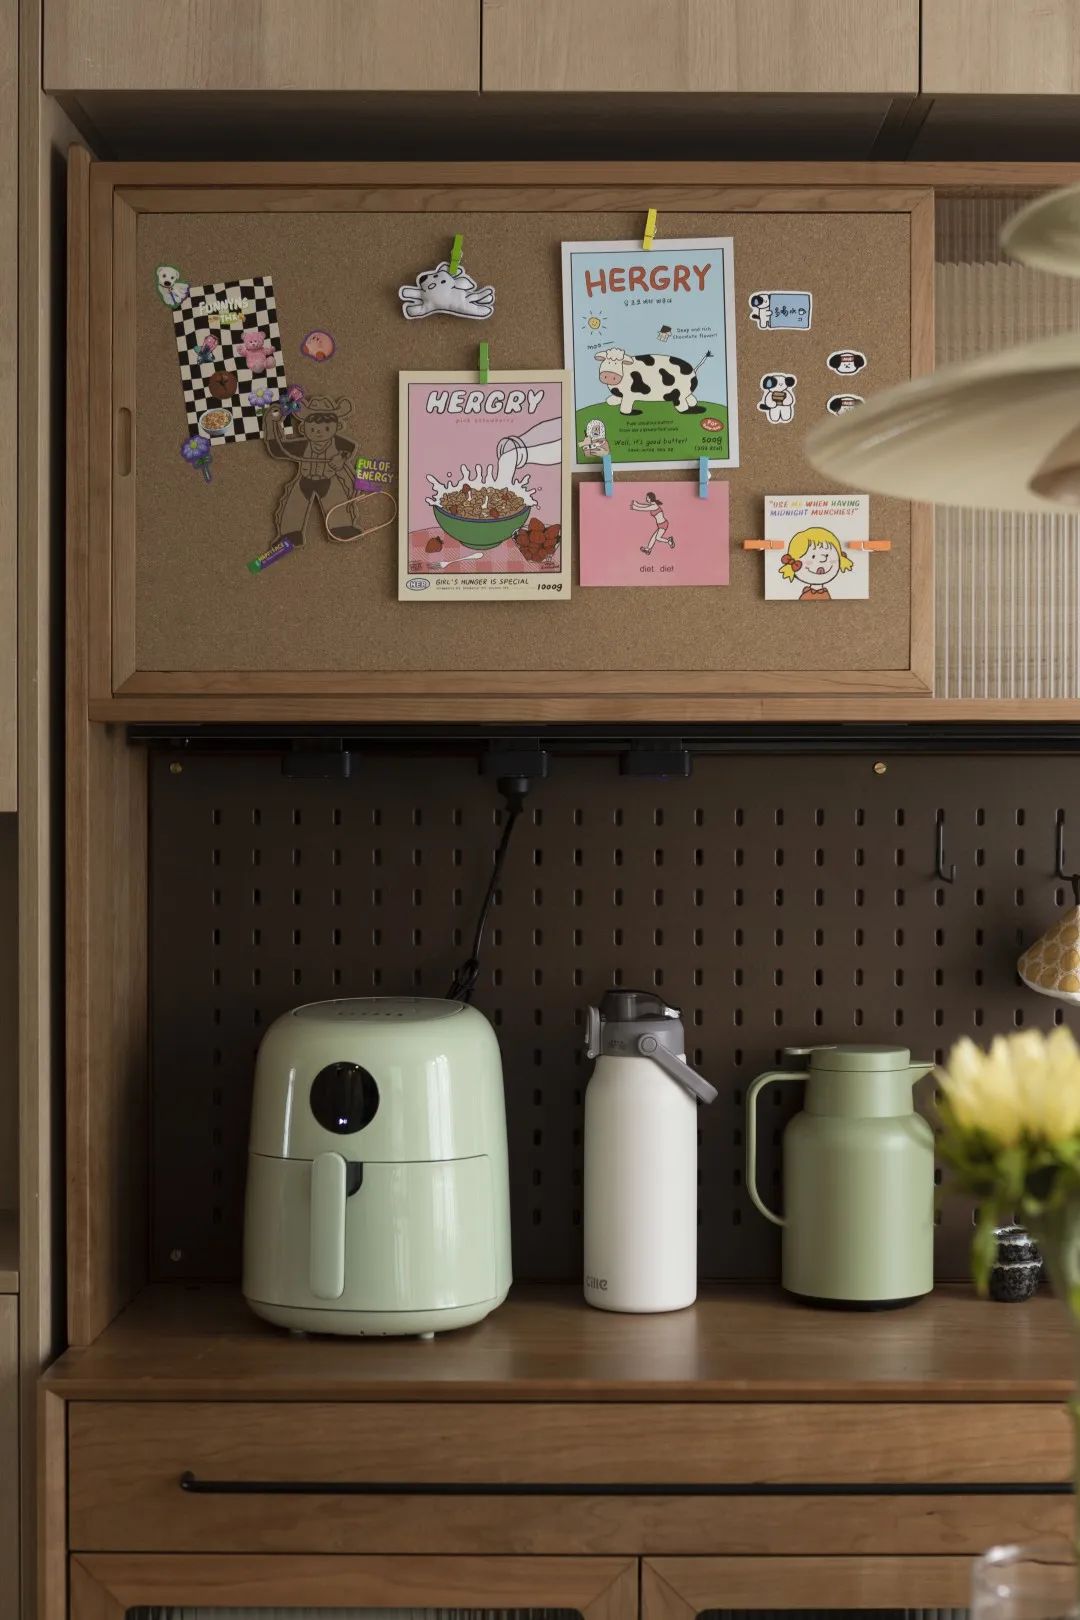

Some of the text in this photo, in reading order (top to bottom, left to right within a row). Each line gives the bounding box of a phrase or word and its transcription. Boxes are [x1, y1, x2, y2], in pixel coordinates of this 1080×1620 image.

[585, 263, 712, 298] HERGRY
[425, 389, 545, 414] HERGRY
[702, 436, 723, 445] 500g
[357, 458, 391, 473] FULL OF
[357, 469, 394, 483] ENERGY
[769, 509, 809, 517] MIDNIGHT
[639, 564, 675, 573] diet diet
[409, 579, 428, 589] HER
[435, 578, 458, 586] GIRL'S
[460, 578, 488, 586] HUNGER
[499, 578, 529, 586] SPECIAL
[537, 583, 563, 592] 1000g
